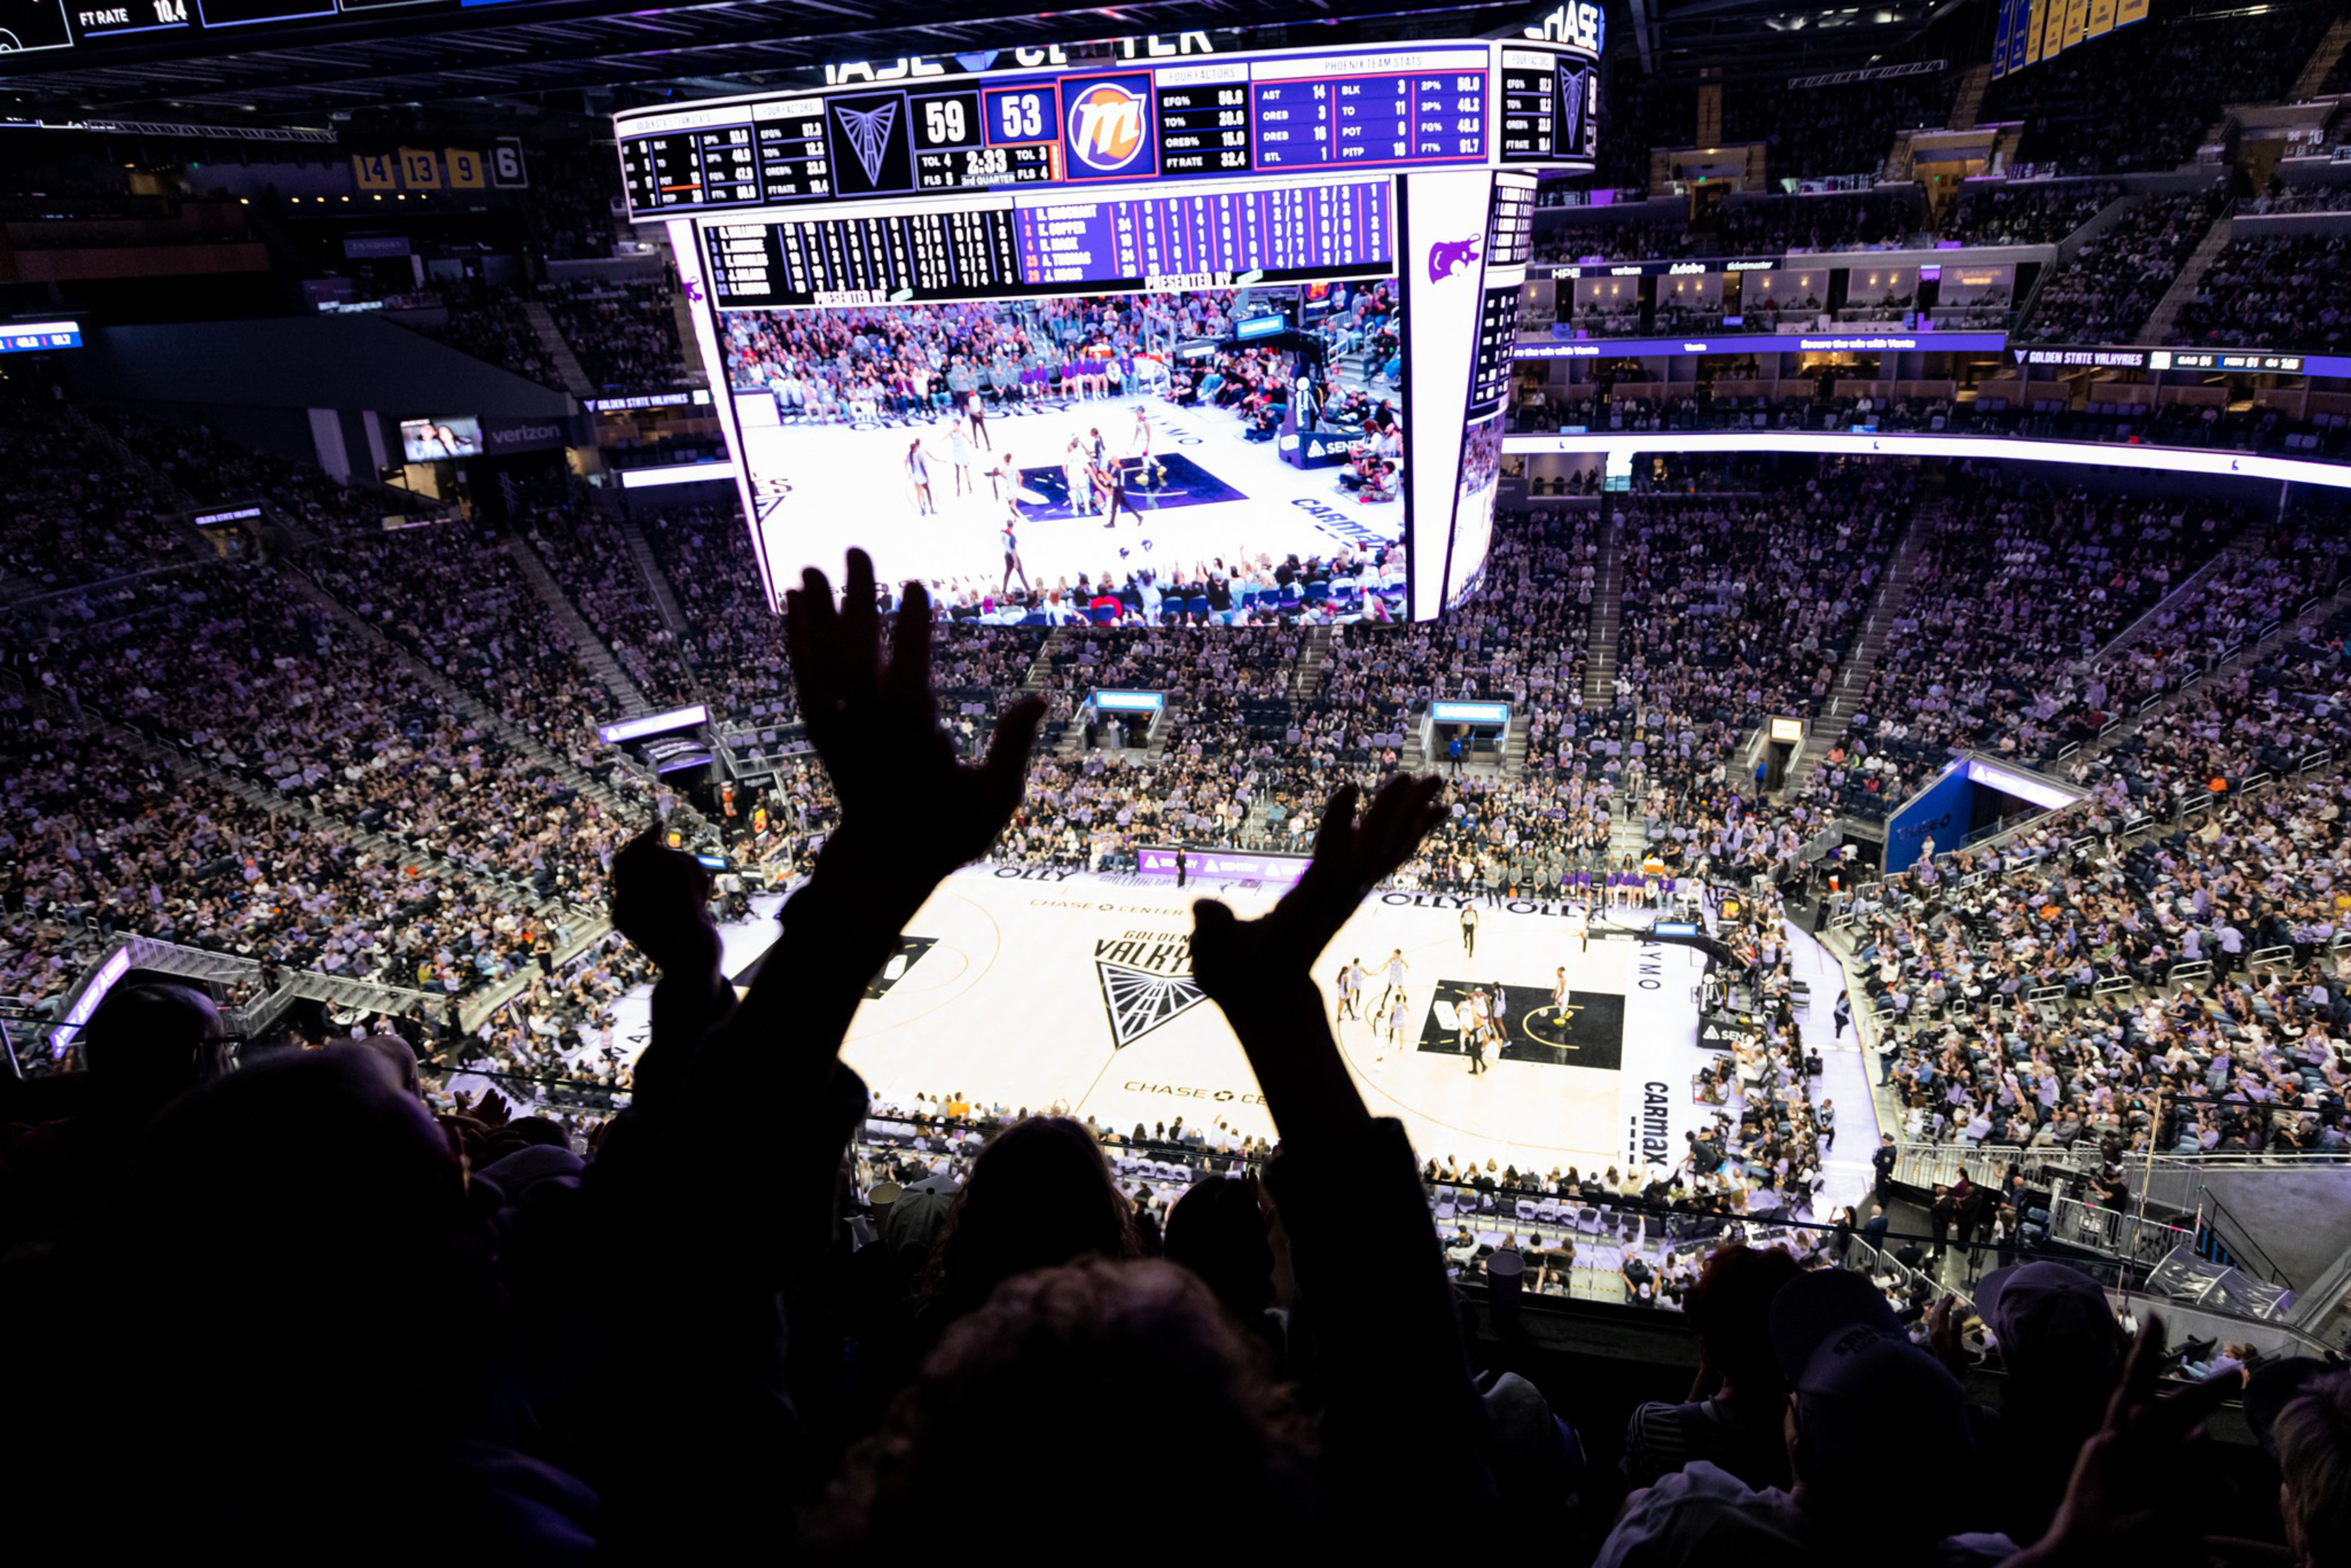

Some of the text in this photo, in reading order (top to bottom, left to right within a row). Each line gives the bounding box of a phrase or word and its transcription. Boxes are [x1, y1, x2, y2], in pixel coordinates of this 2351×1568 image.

[80, 8, 130, 26] FT RATE
[153, 0, 188, 23] 10.4
[1325, 56, 1422, 71] PHOENIX TEAM STATS
[1169, 67, 1235, 82] FOUR FACTORS
[1313, 84, 1325, 99] 14
[1341, 85, 1360, 96] BLK
[1398, 80, 1406, 94] 3
[1421, 81, 1441, 91] 2P%
[1164, 97, 1191, 107] EFG%
[1262, 90, 1281, 100] AST
[1318, 105, 1327, 120] 3
[1342, 106, 1355, 116] TO
[1395, 100, 1406, 115] 11
[1421, 102, 1442, 111] 3P%
[925, 100, 966, 143] 59
[1000, 94, 1042, 138] 53
[1164, 117, 1187, 127] TO%
[1262, 110, 1289, 121] OREB
[1343, 126, 1362, 137] POT
[1421, 122, 1442, 132] FG%
[689, 135, 696, 148] 1
[1165, 137, 1200, 148] OREB%
[1221, 131, 1245, 146] 15.0
[1263, 131, 1289, 141] DREB
[1015, 146, 1047, 160] TOL 3
[1321, 146, 1327, 161] 1
[1343, 148, 1365, 157] PITP
[1421, 143, 1441, 153] FT%
[497, 148, 519, 178] 6
[922, 153, 952, 167] TOL 4
[966, 149, 1008, 174] 2:33
[1166, 157, 1203, 168] FT RATE
[1221, 151, 1245, 167] 32.4
[1264, 152, 1281, 162] STL
[360, 155, 388, 182] 14
[408, 157, 433, 182] 13
[458, 157, 473, 181] 9
[1018, 165, 1048, 179] FLS 4
[924, 172, 953, 186] FLS 5
[961, 174, 1016, 186] 3rd QUARTER
[1670, 263, 1705, 274] Adobe
[1727, 261, 1773, 271] ticketmaster
[1144, 272, 1212, 290] PRESENTED
[1215, 270, 1232, 286] BY
[1552, 268, 1580, 279] HPE
[814, 290, 871, 305] PRESENTED
[1832, 339, 1848, 348] the
[2028, 351, 2062, 363] GOLDEN
[2063, 351, 2093, 364] STATE
[2094, 353, 2143, 366] VALKYRIES
[598, 394, 689, 411] GOLDEN STATE VALKYRIES
[492, 424, 560, 443] verizon
[994, 866, 1076, 882] OLLY
[1220, 861, 1259, 873] SENTRY
[1030, 898, 1183, 917] CHASE CENTER
[1382, 893, 1473, 910] OLLY
[1123, 930, 1191, 943] GOLDEN
[1124, 1081, 1209, 1100] CHASE
